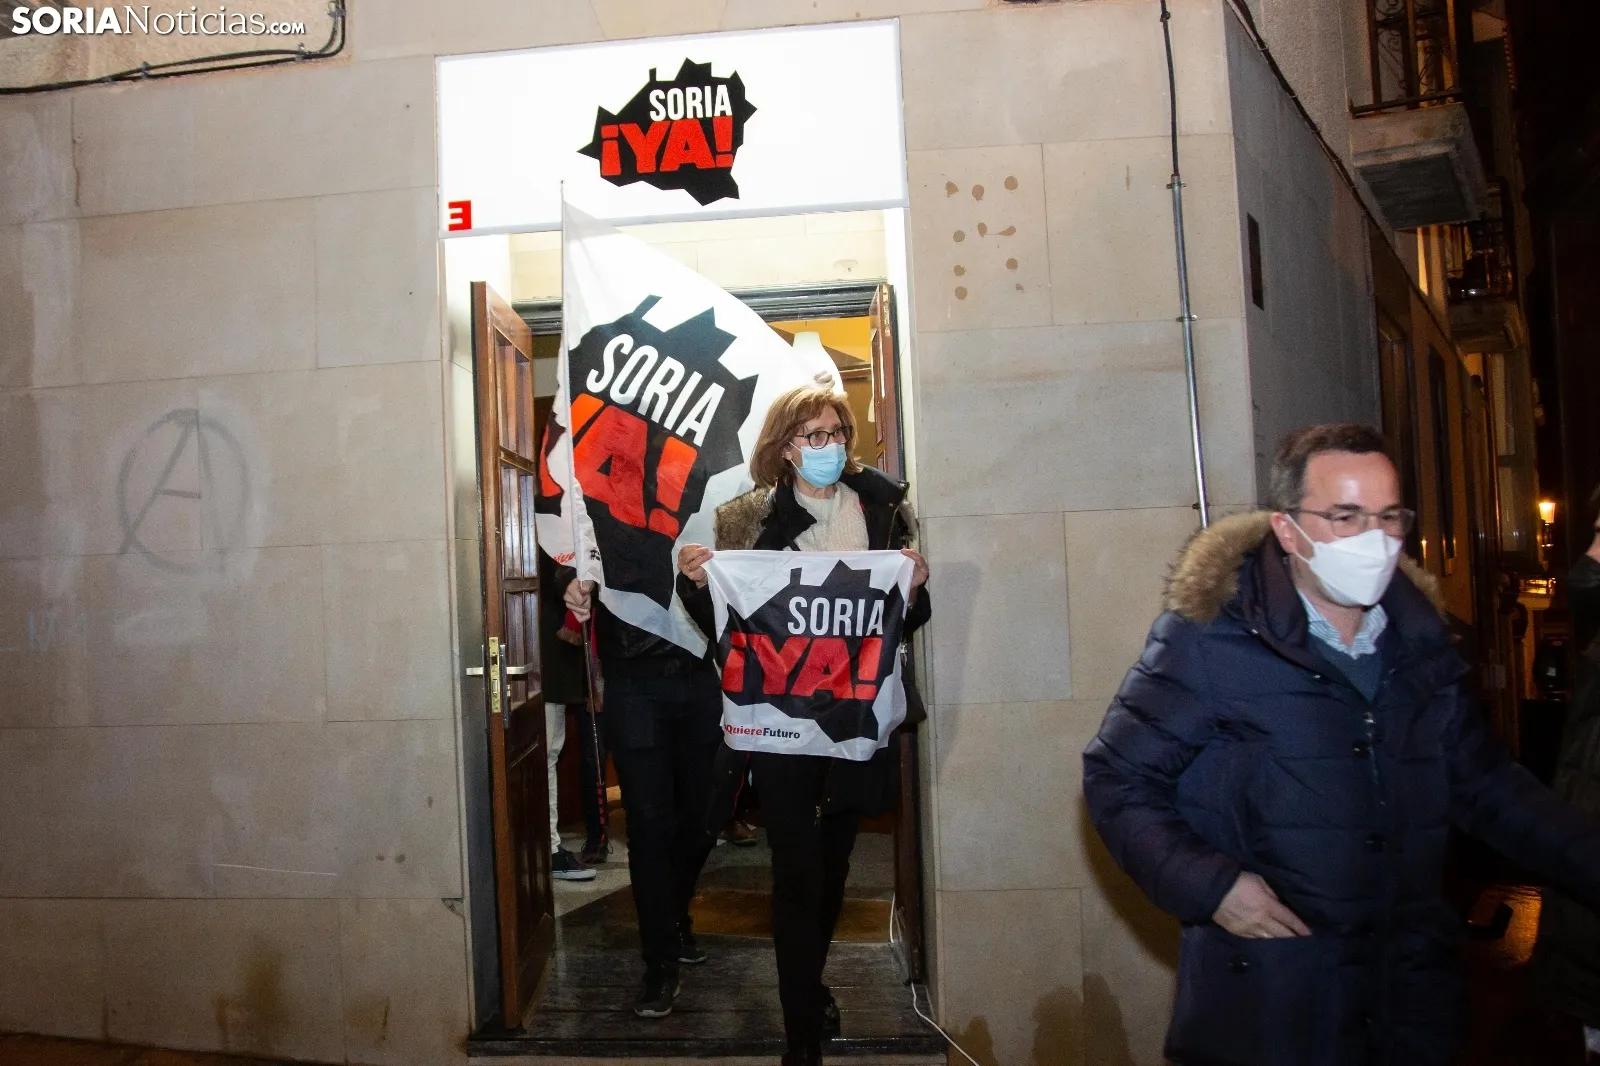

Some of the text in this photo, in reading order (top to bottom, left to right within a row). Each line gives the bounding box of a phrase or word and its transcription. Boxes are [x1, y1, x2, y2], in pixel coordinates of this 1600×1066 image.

[649, 85, 733, 121] SORIA
[601, 116, 734, 176] ¡YA!
[586, 333, 726, 447] SORIA
[788, 596, 884, 636] SORIA
[722, 631, 883, 700] ¡YA!
